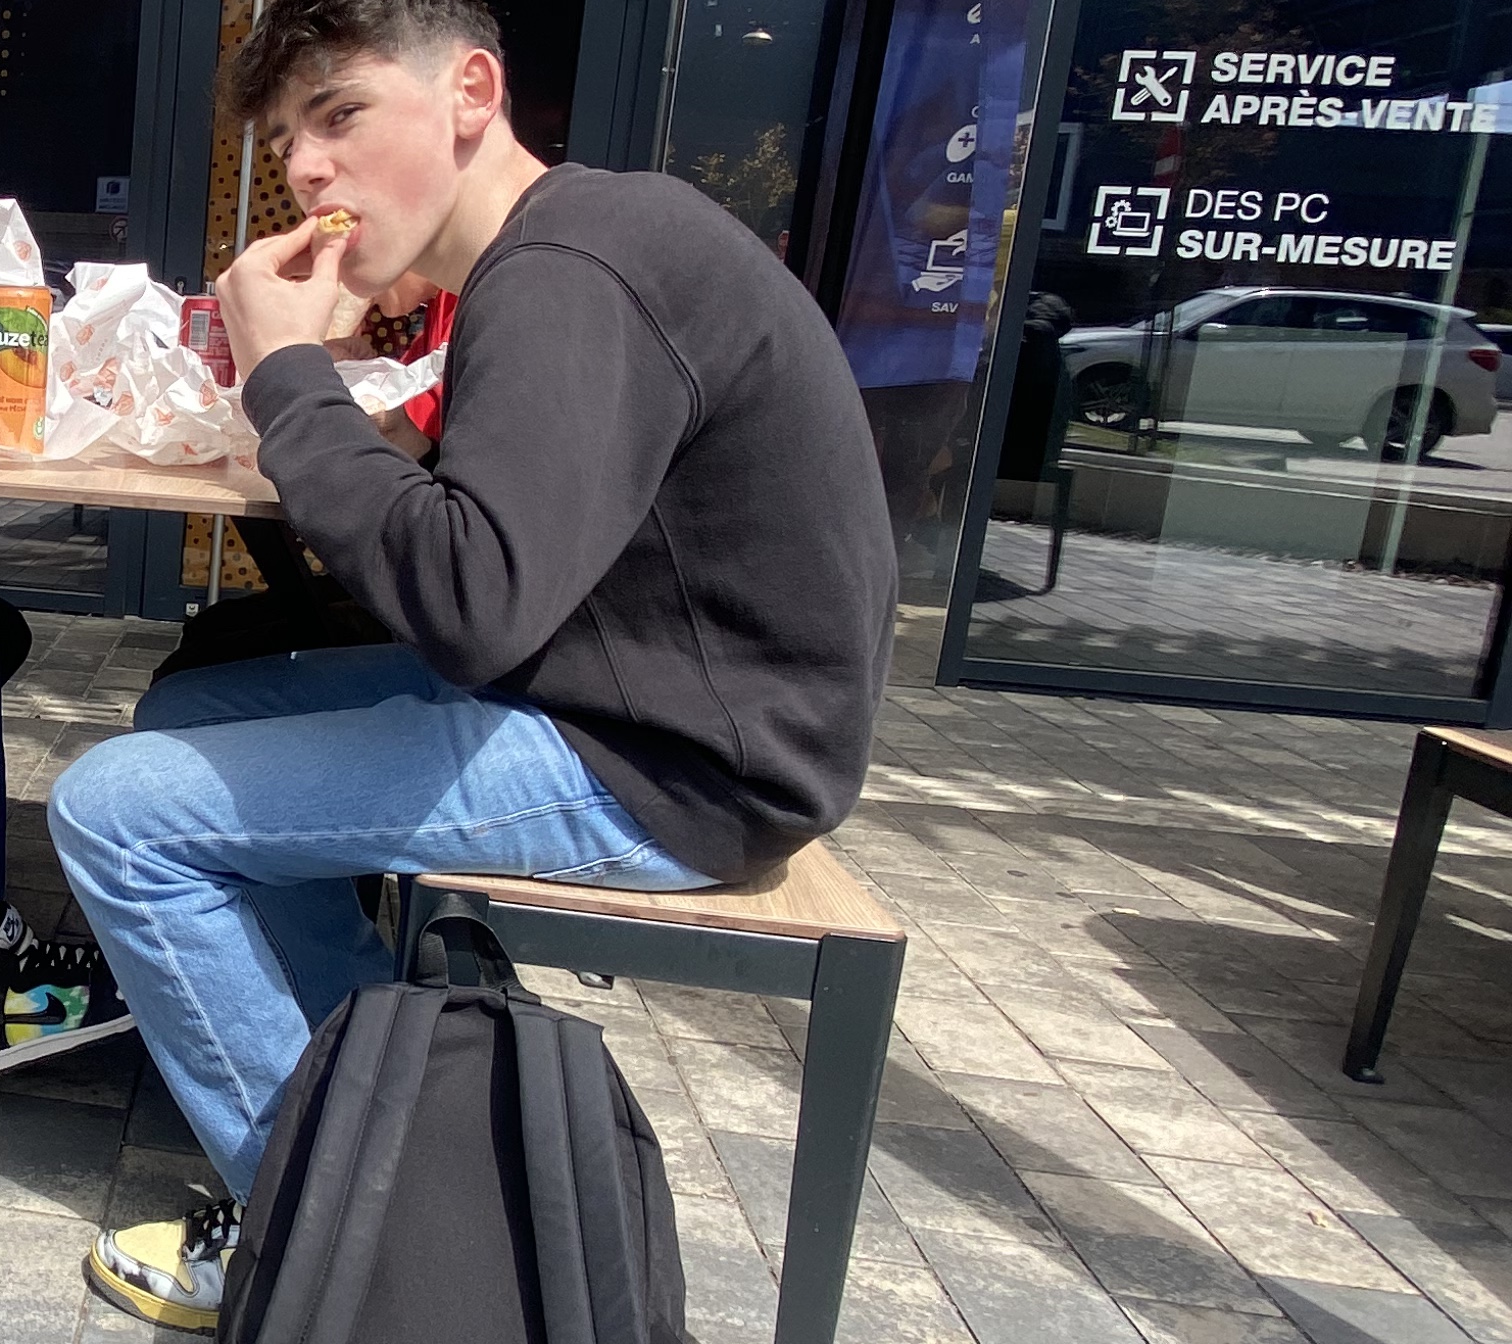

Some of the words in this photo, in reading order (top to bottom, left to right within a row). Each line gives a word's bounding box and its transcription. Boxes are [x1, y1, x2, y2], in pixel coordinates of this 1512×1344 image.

[1210, 52, 1397, 87] SERVICE
[1201, 89, 1500, 133] APRÈS-VENTE
[1185, 188, 1264, 222] DES
[1273, 192, 1331, 224] PC
[1176, 229, 1458, 272] SUR-MESURE
[931, 301, 959, 314] SAV
